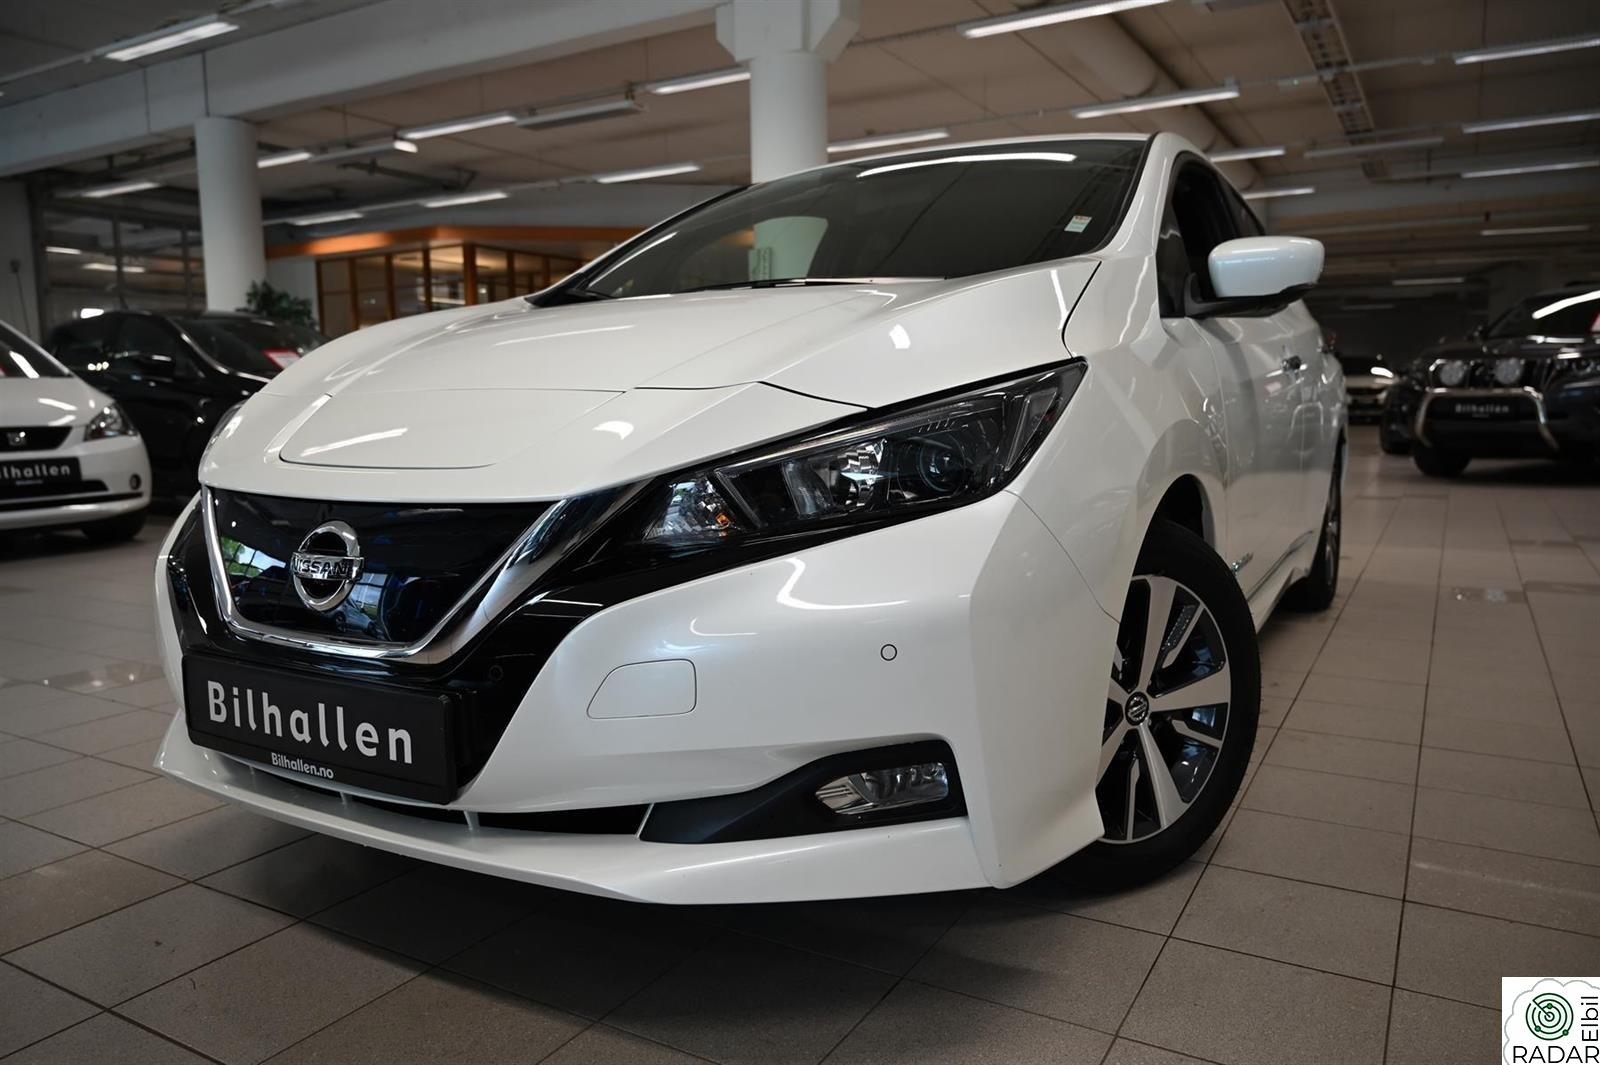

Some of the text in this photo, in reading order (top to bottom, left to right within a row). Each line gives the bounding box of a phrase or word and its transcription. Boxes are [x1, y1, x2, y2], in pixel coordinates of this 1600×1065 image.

[0, 464, 70, 479] lhallen
[207, 680, 412, 764] Bilhallen
[271, 752, 334, 780] Bilhallen.no
